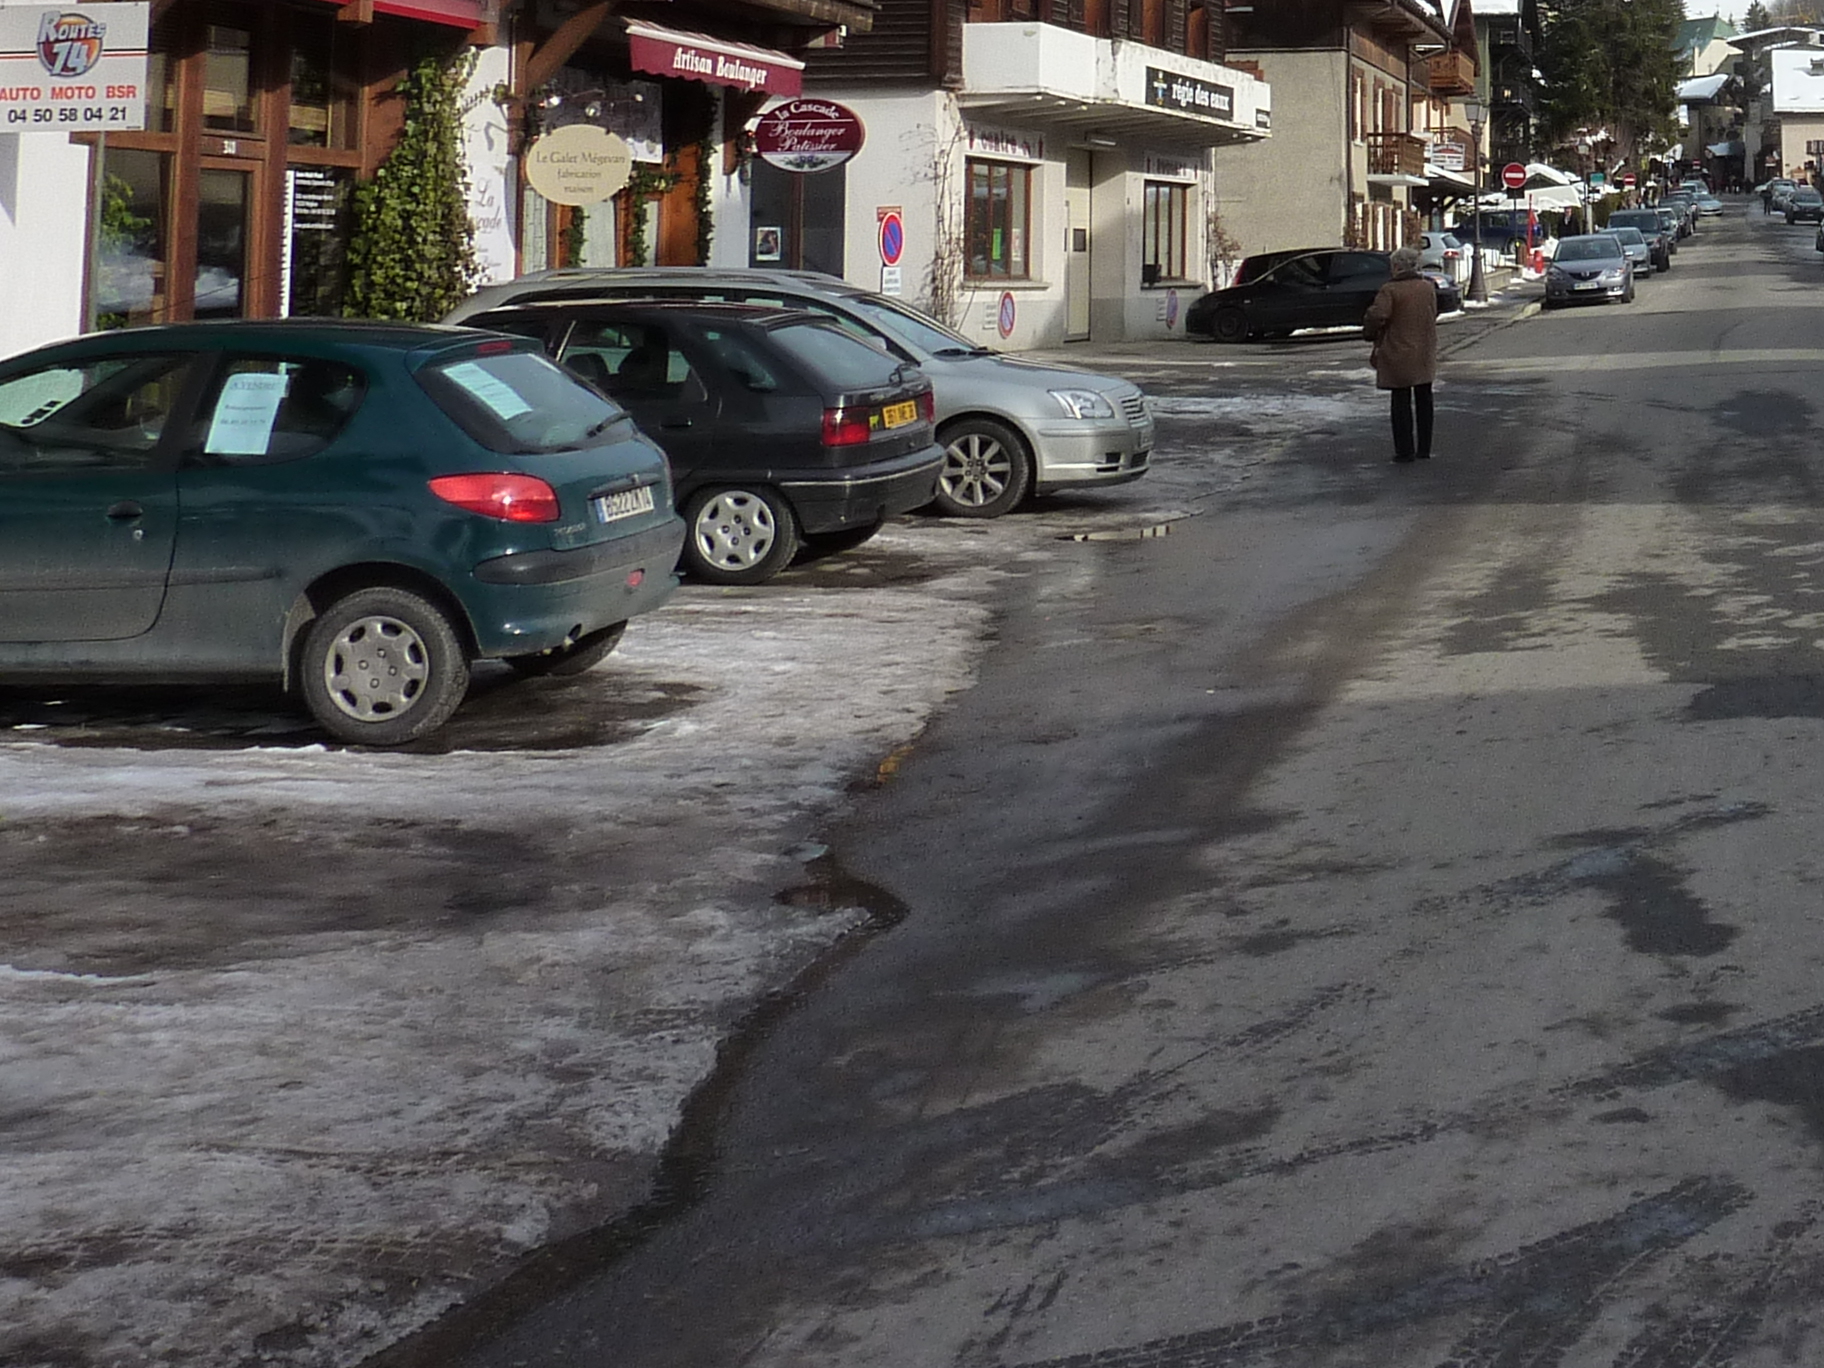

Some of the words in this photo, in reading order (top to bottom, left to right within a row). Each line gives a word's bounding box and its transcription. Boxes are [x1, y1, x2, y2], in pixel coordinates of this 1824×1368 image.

[50, 41, 89, 76] 74
[673, 47, 712, 74] Artisan
[716, 56, 767, 88] Boulanger
[0, 88, 42, 100] AUTO
[50, 86, 96, 100] MOTO
[105, 85, 137, 99] BSR
[1172, 78, 1193, 107] régie
[1195, 84, 1209, 107] des
[1210, 93, 1229, 111] eaux
[8, 109, 27, 123] 04
[33, 109, 53, 122] 50
[58, 108, 78, 122] 58
[84, 107, 103, 122] 04
[109, 106, 127, 121] 21
[789, 102, 839, 119] Cascade
[768, 121, 846, 143] Boulanger
[536, 151, 548, 163] Le
[549, 151, 577, 164] Galet
[557, 169, 602, 179] fabrication
